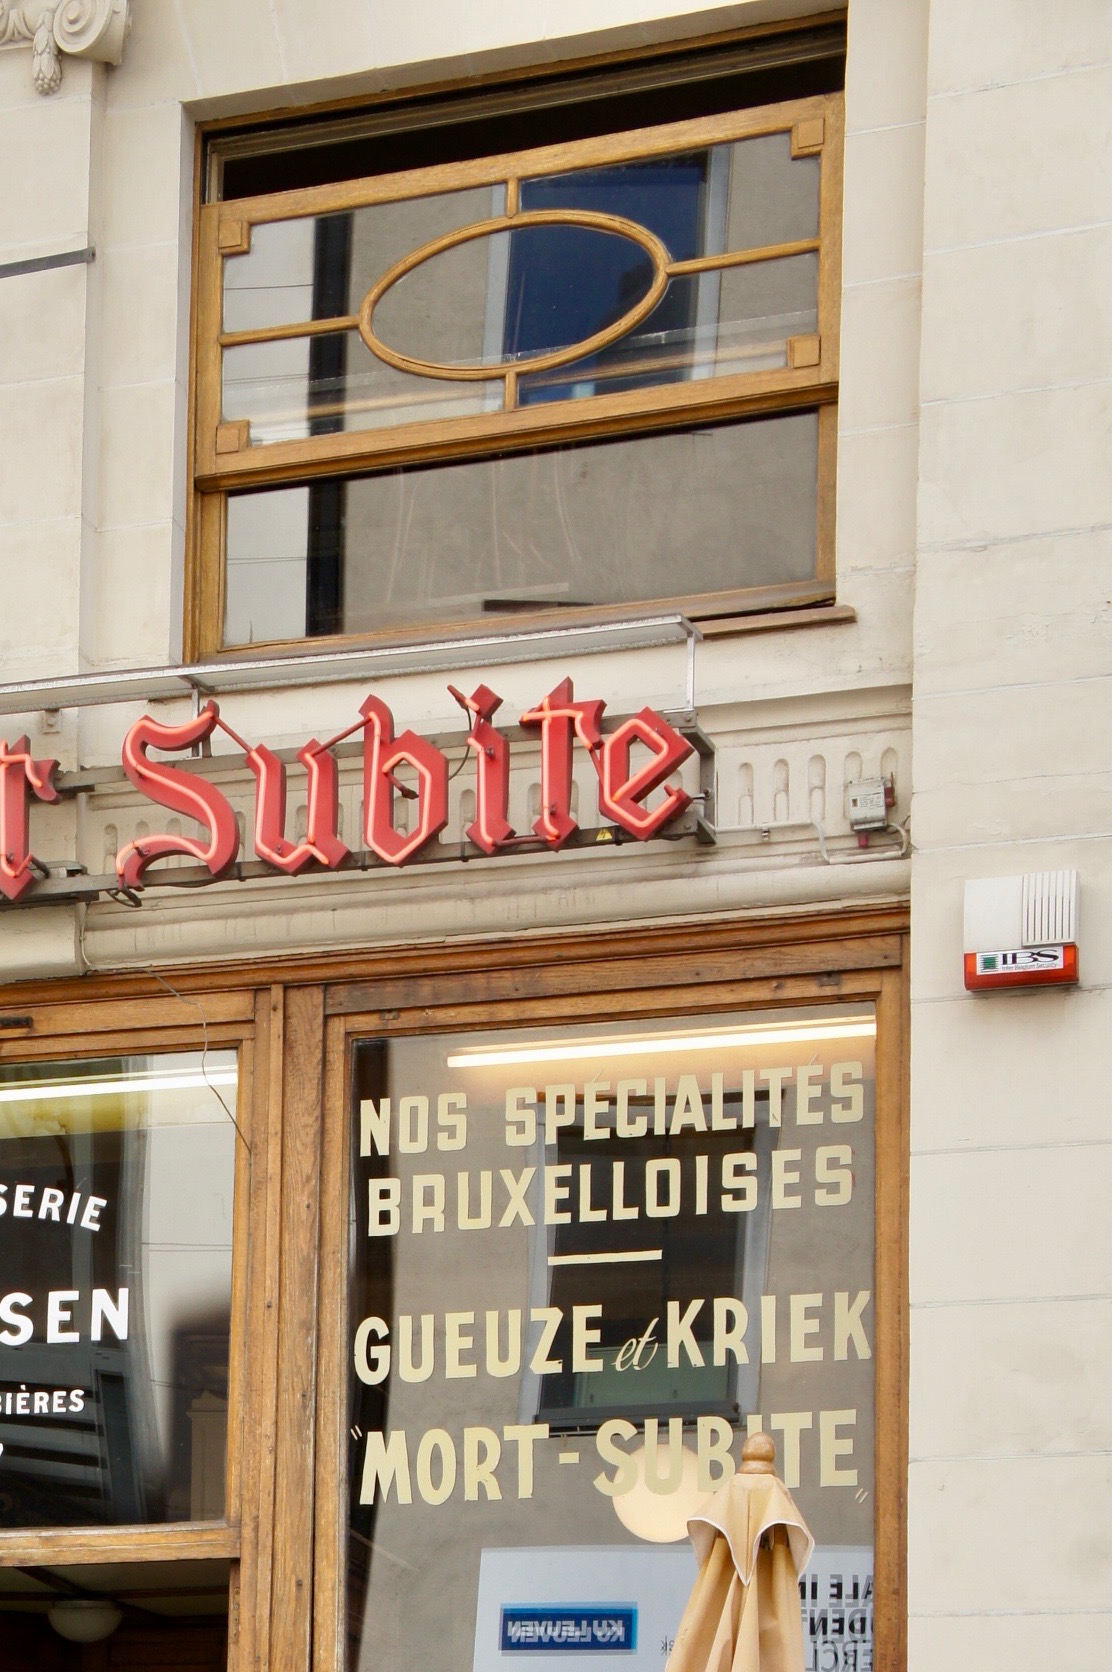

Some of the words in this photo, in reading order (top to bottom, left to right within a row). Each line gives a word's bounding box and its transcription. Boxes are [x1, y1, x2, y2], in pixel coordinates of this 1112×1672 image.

[116, 676, 695, 890] Subite
[1001, 949, 1059, 966] IBS
[360, 1092, 467, 1157] NOS
[505, 1053, 865, 1147] SPÉCIALITÉS
[368, 1145, 855, 1237] BRUXELLOISES
[354, 1305, 604, 1385] GUEUZE
[611, 1316, 659, 1372] et
[667, 1290, 872, 1369] KRIEK
